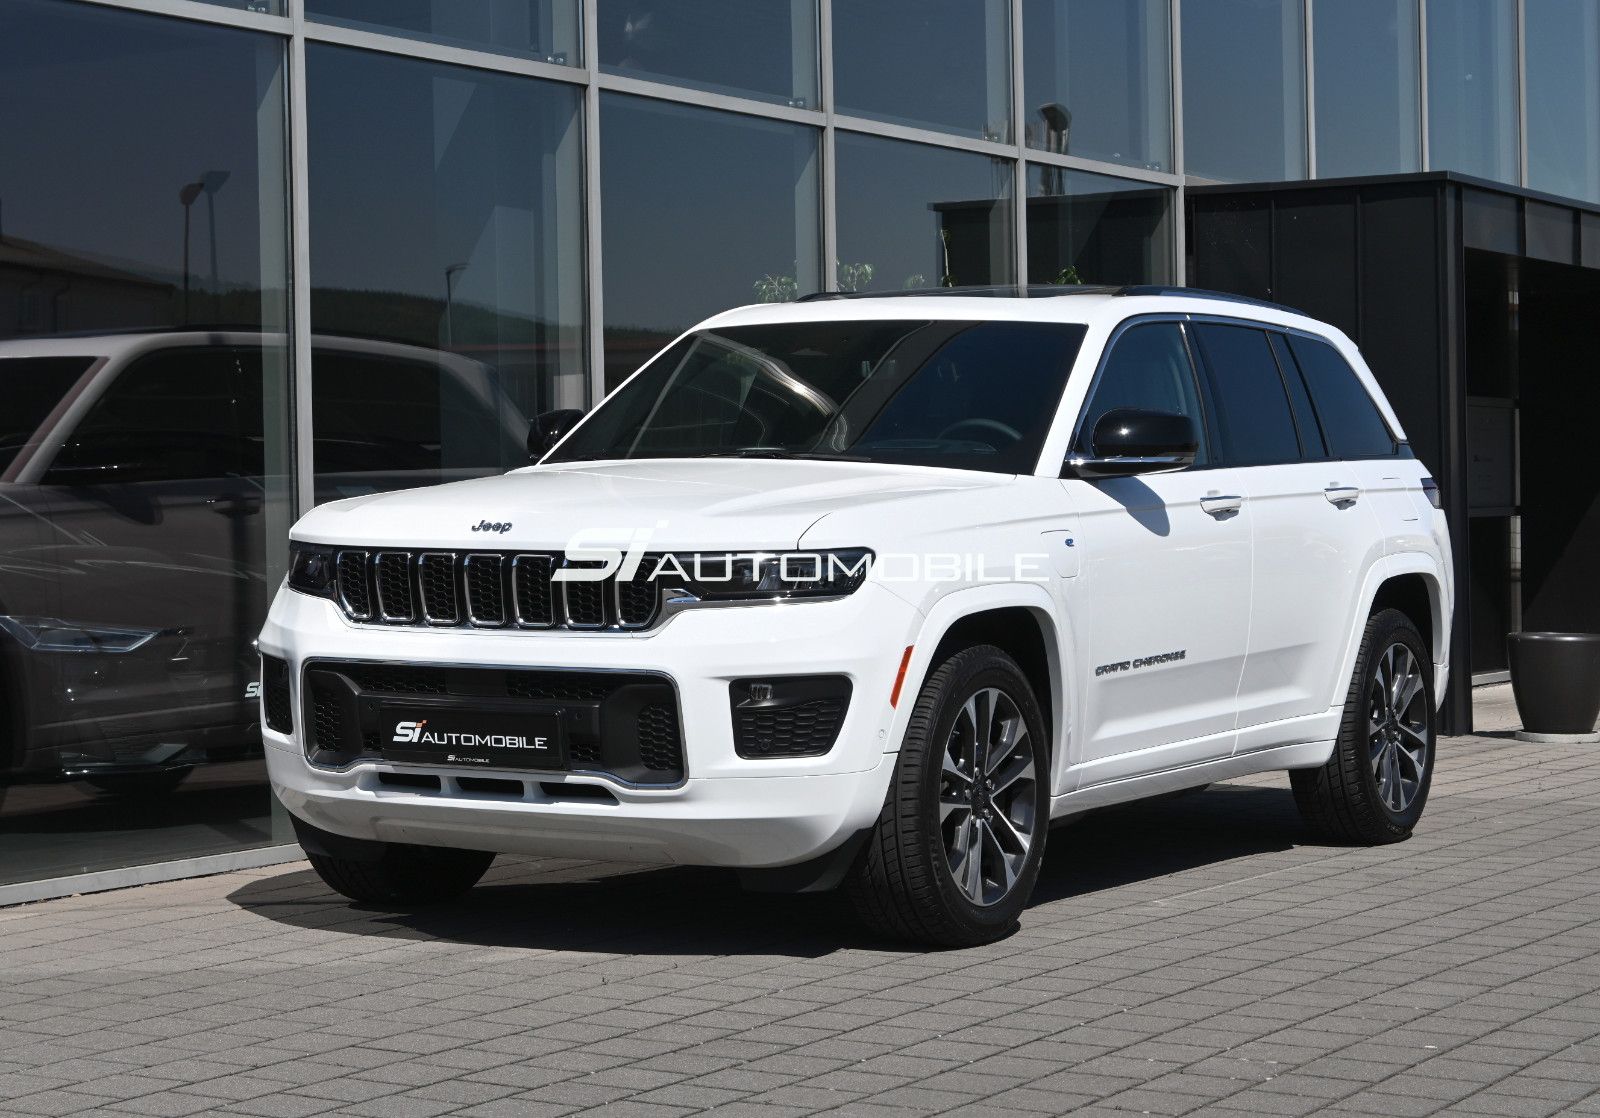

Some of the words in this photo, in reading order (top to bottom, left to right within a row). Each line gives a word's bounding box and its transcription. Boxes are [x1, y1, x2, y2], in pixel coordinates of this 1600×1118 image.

[471, 519, 513, 535] Jeep
[1095, 660, 1131, 677] GRAND
[1132, 649, 1186, 669] CHEROKEE
[421, 733, 547, 749] AUTOMOBILE
